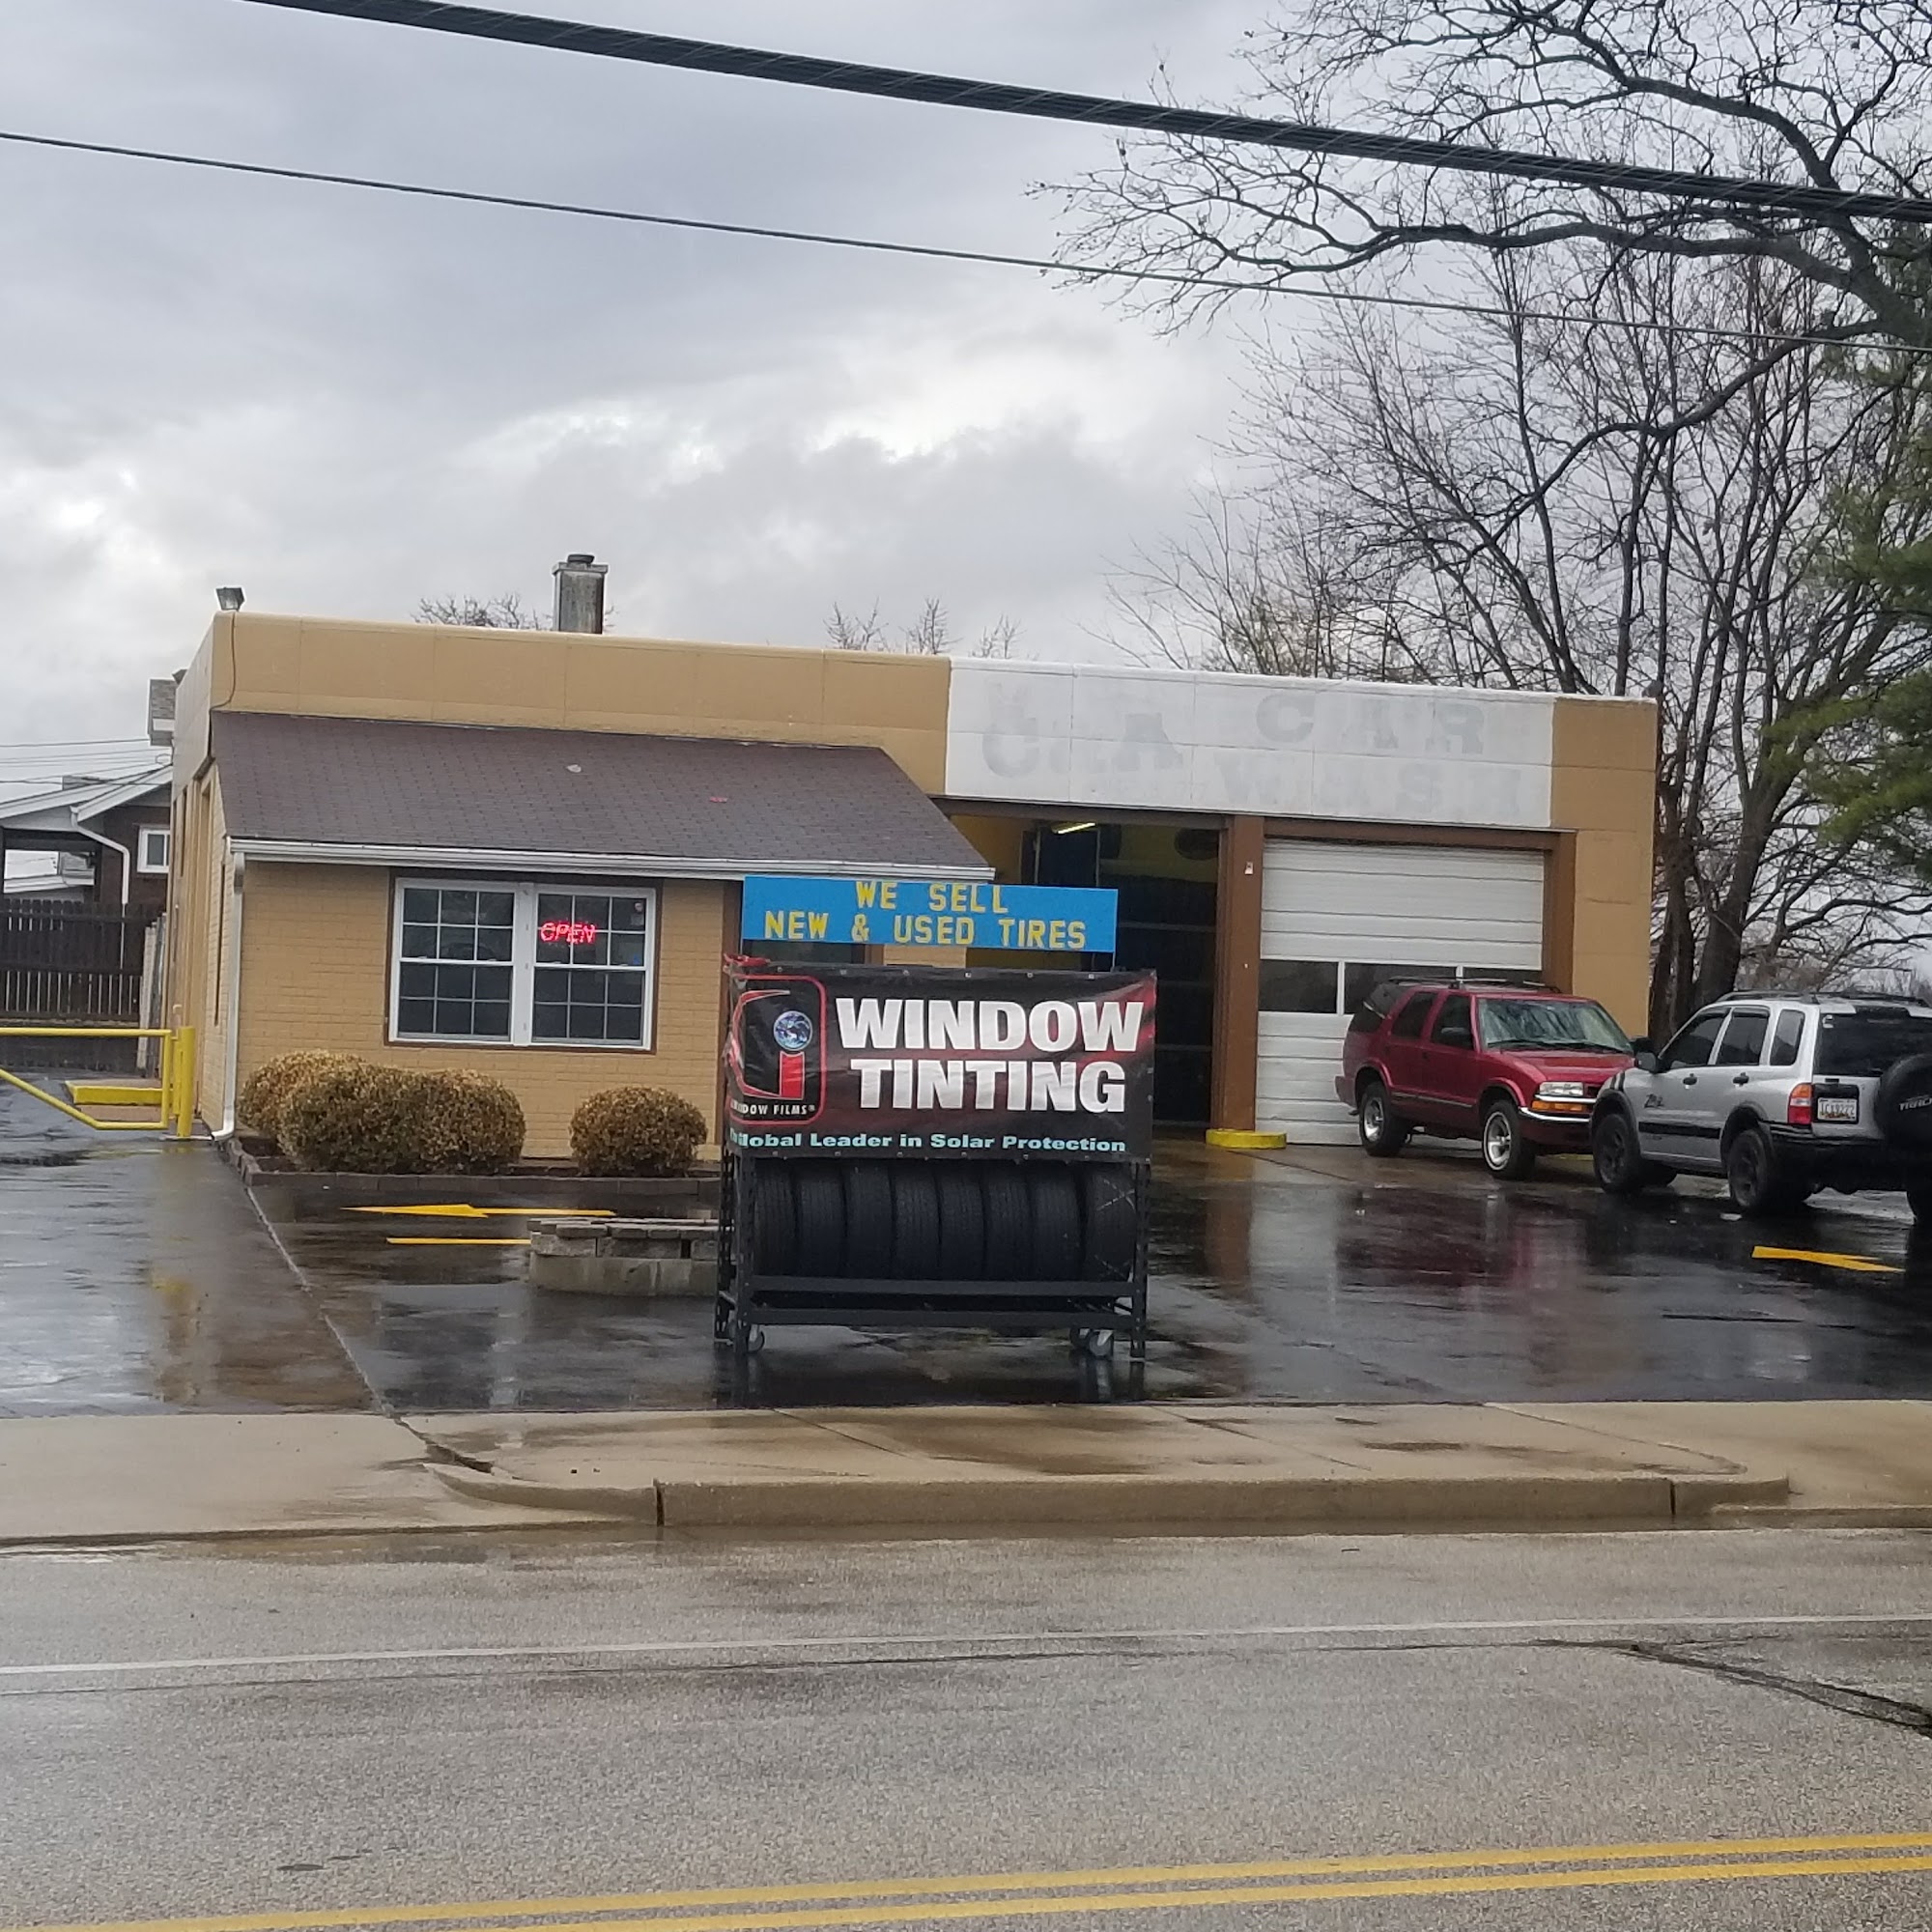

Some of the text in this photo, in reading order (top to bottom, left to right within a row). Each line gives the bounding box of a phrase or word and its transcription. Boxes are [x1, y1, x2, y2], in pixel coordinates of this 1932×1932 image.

[855, 881, 1009, 914] WE SELL
[540, 922, 596, 944] OPEN
[764, 910, 1086, 950] NEW & USED TIRES
[836, 997, 1144, 1052] WINDOW
[850, 1059, 1125, 1113] TINTING
[810, 1132, 892, 1148] Leader
[900, 1133, 922, 1148] in
[930, 1133, 995, 1149] Solar
[1002, 1135, 1125, 1151] Protection
